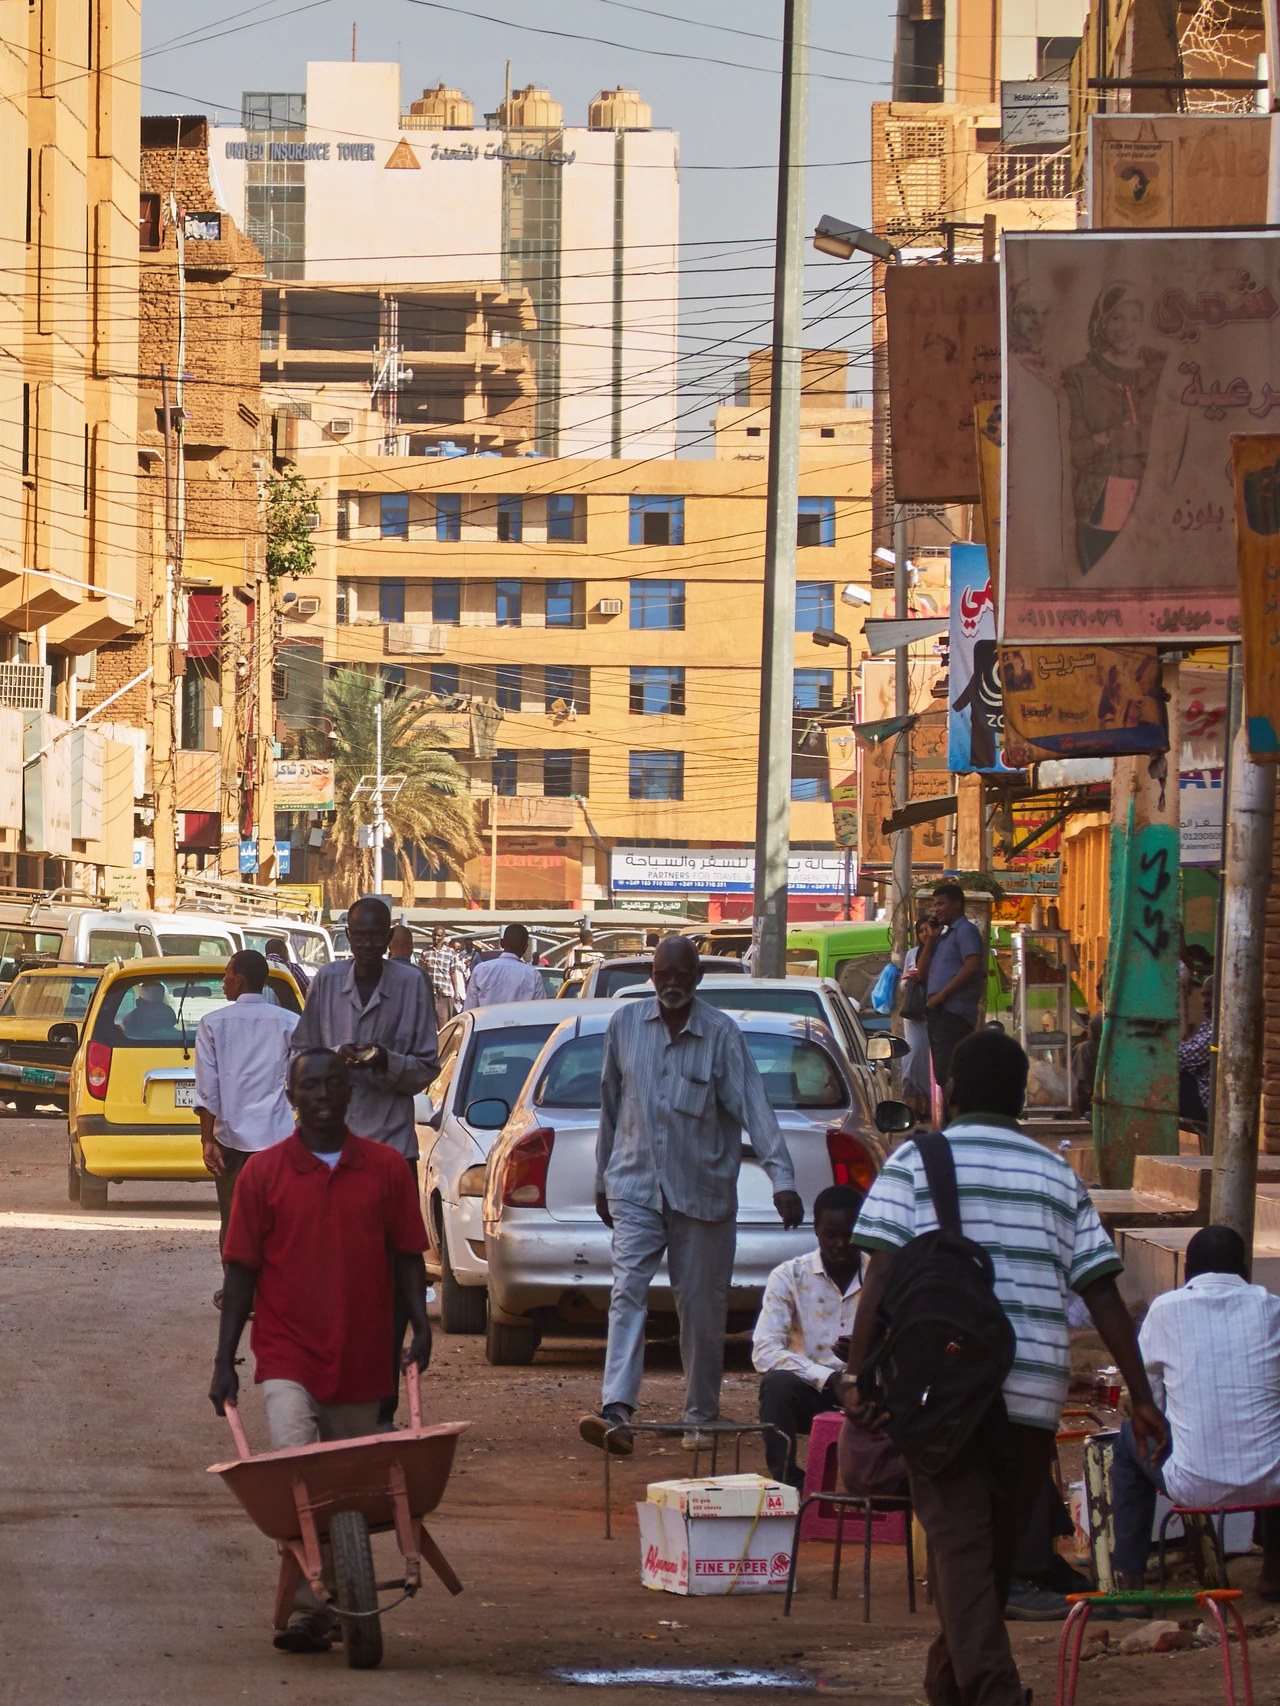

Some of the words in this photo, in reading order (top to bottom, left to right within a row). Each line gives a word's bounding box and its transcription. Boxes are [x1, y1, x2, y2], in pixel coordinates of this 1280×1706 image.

[225, 142, 265, 160] UNITED
[269, 142, 330, 160] INSURANCE
[337, 142, 375, 161] TOWER
[1038, 652, 1096, 680] سريع
[275, 761, 297, 778] شاكر
[300, 763, 330, 777] عطارة
[625, 853, 696, 870] والسياحة
[700, 855, 748, 871] للسفر
[648, 872, 690, 880] PARTNERS
[713, 873, 742, 881] TRAVEL
[792, 874, 830, 882] AGENCY
[768, 1497, 782, 1508] A4
[695, 1562, 724, 1573] FINE
[728, 1562, 768, 1573] PAPER
